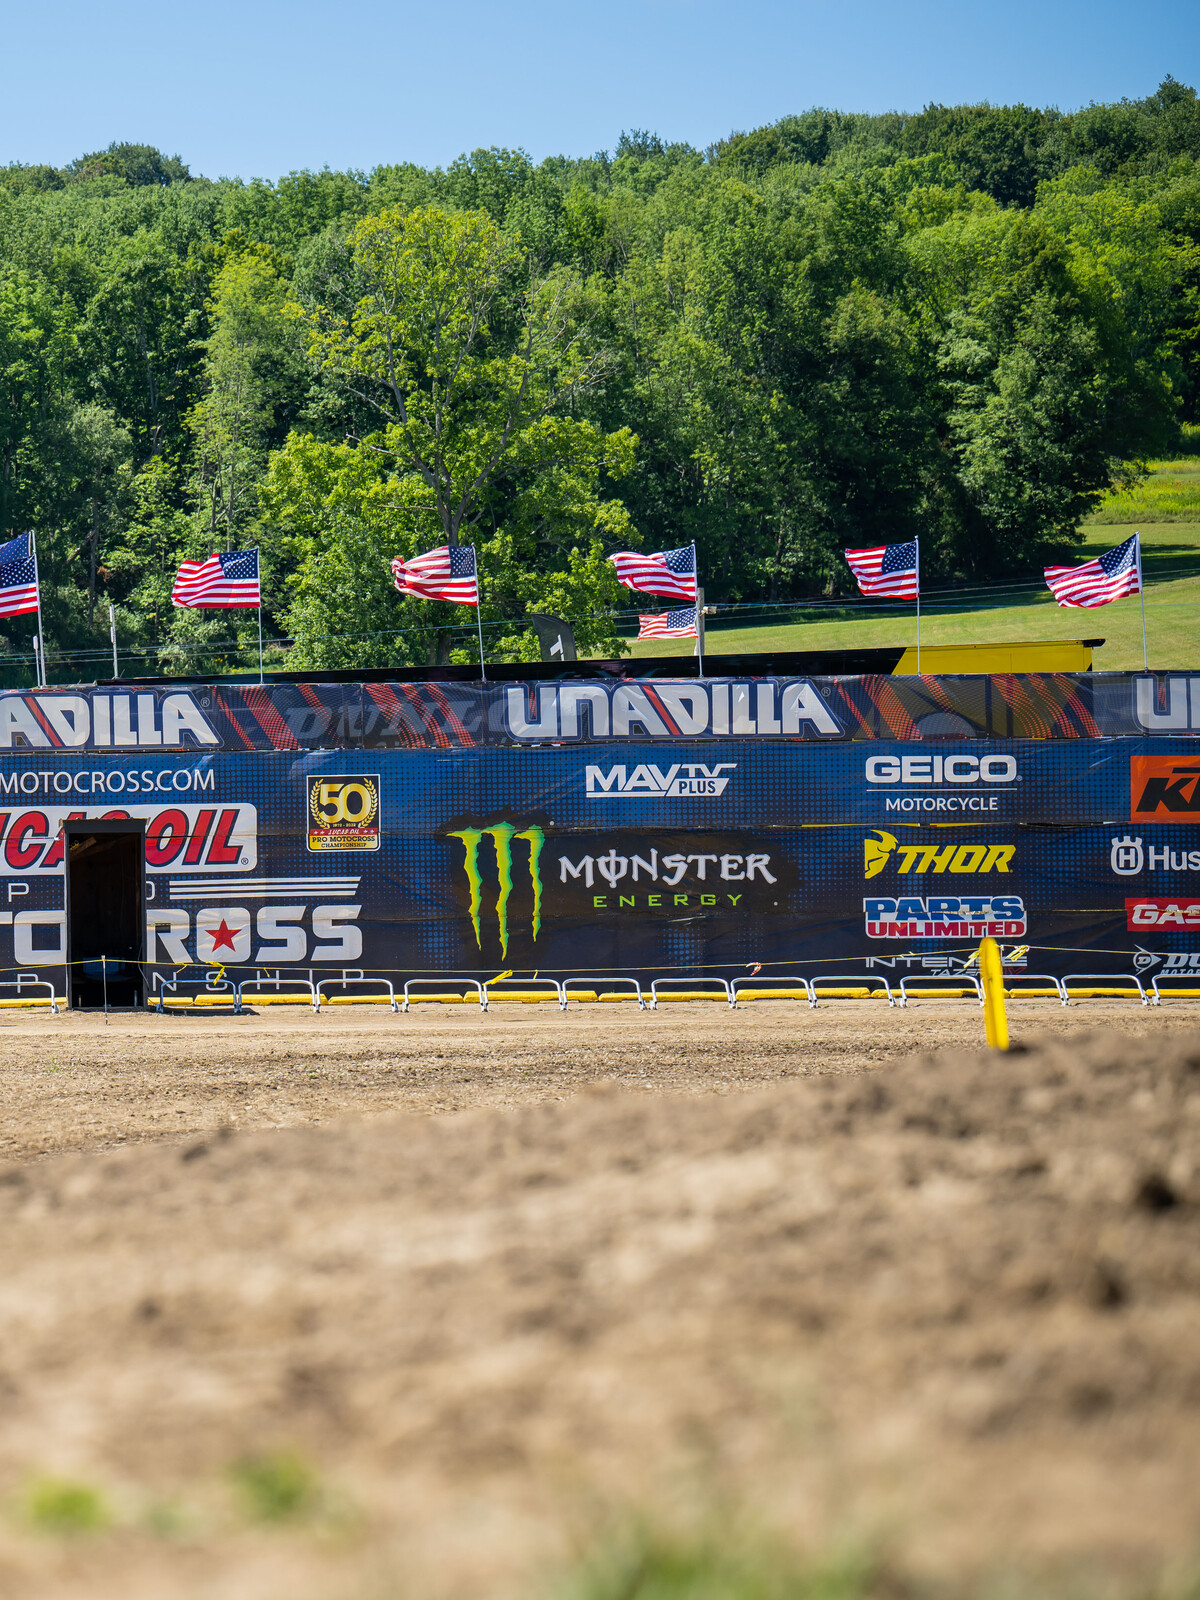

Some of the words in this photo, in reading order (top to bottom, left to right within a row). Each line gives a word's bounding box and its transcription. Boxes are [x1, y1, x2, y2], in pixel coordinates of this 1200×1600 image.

[507, 683, 841, 737] UNADILLA
[585, 763, 738, 791] MAVTV
[865, 755, 1017, 783] GEICO
[678, 780, 716, 794] PLUS
[319, 783, 372, 823] 50
[885, 797, 998, 811] MOTORCYCLE
[146, 809, 241, 866] OIL
[558, 848, 777, 888] MONSTER
[897, 844, 1016, 874] THOR
[593, 894, 743, 907] ENERGY
[863, 897, 1024, 921] PARTS
[867, 920, 1025, 937] UNLIMITED
[866, 956, 1027, 968] INTENE
